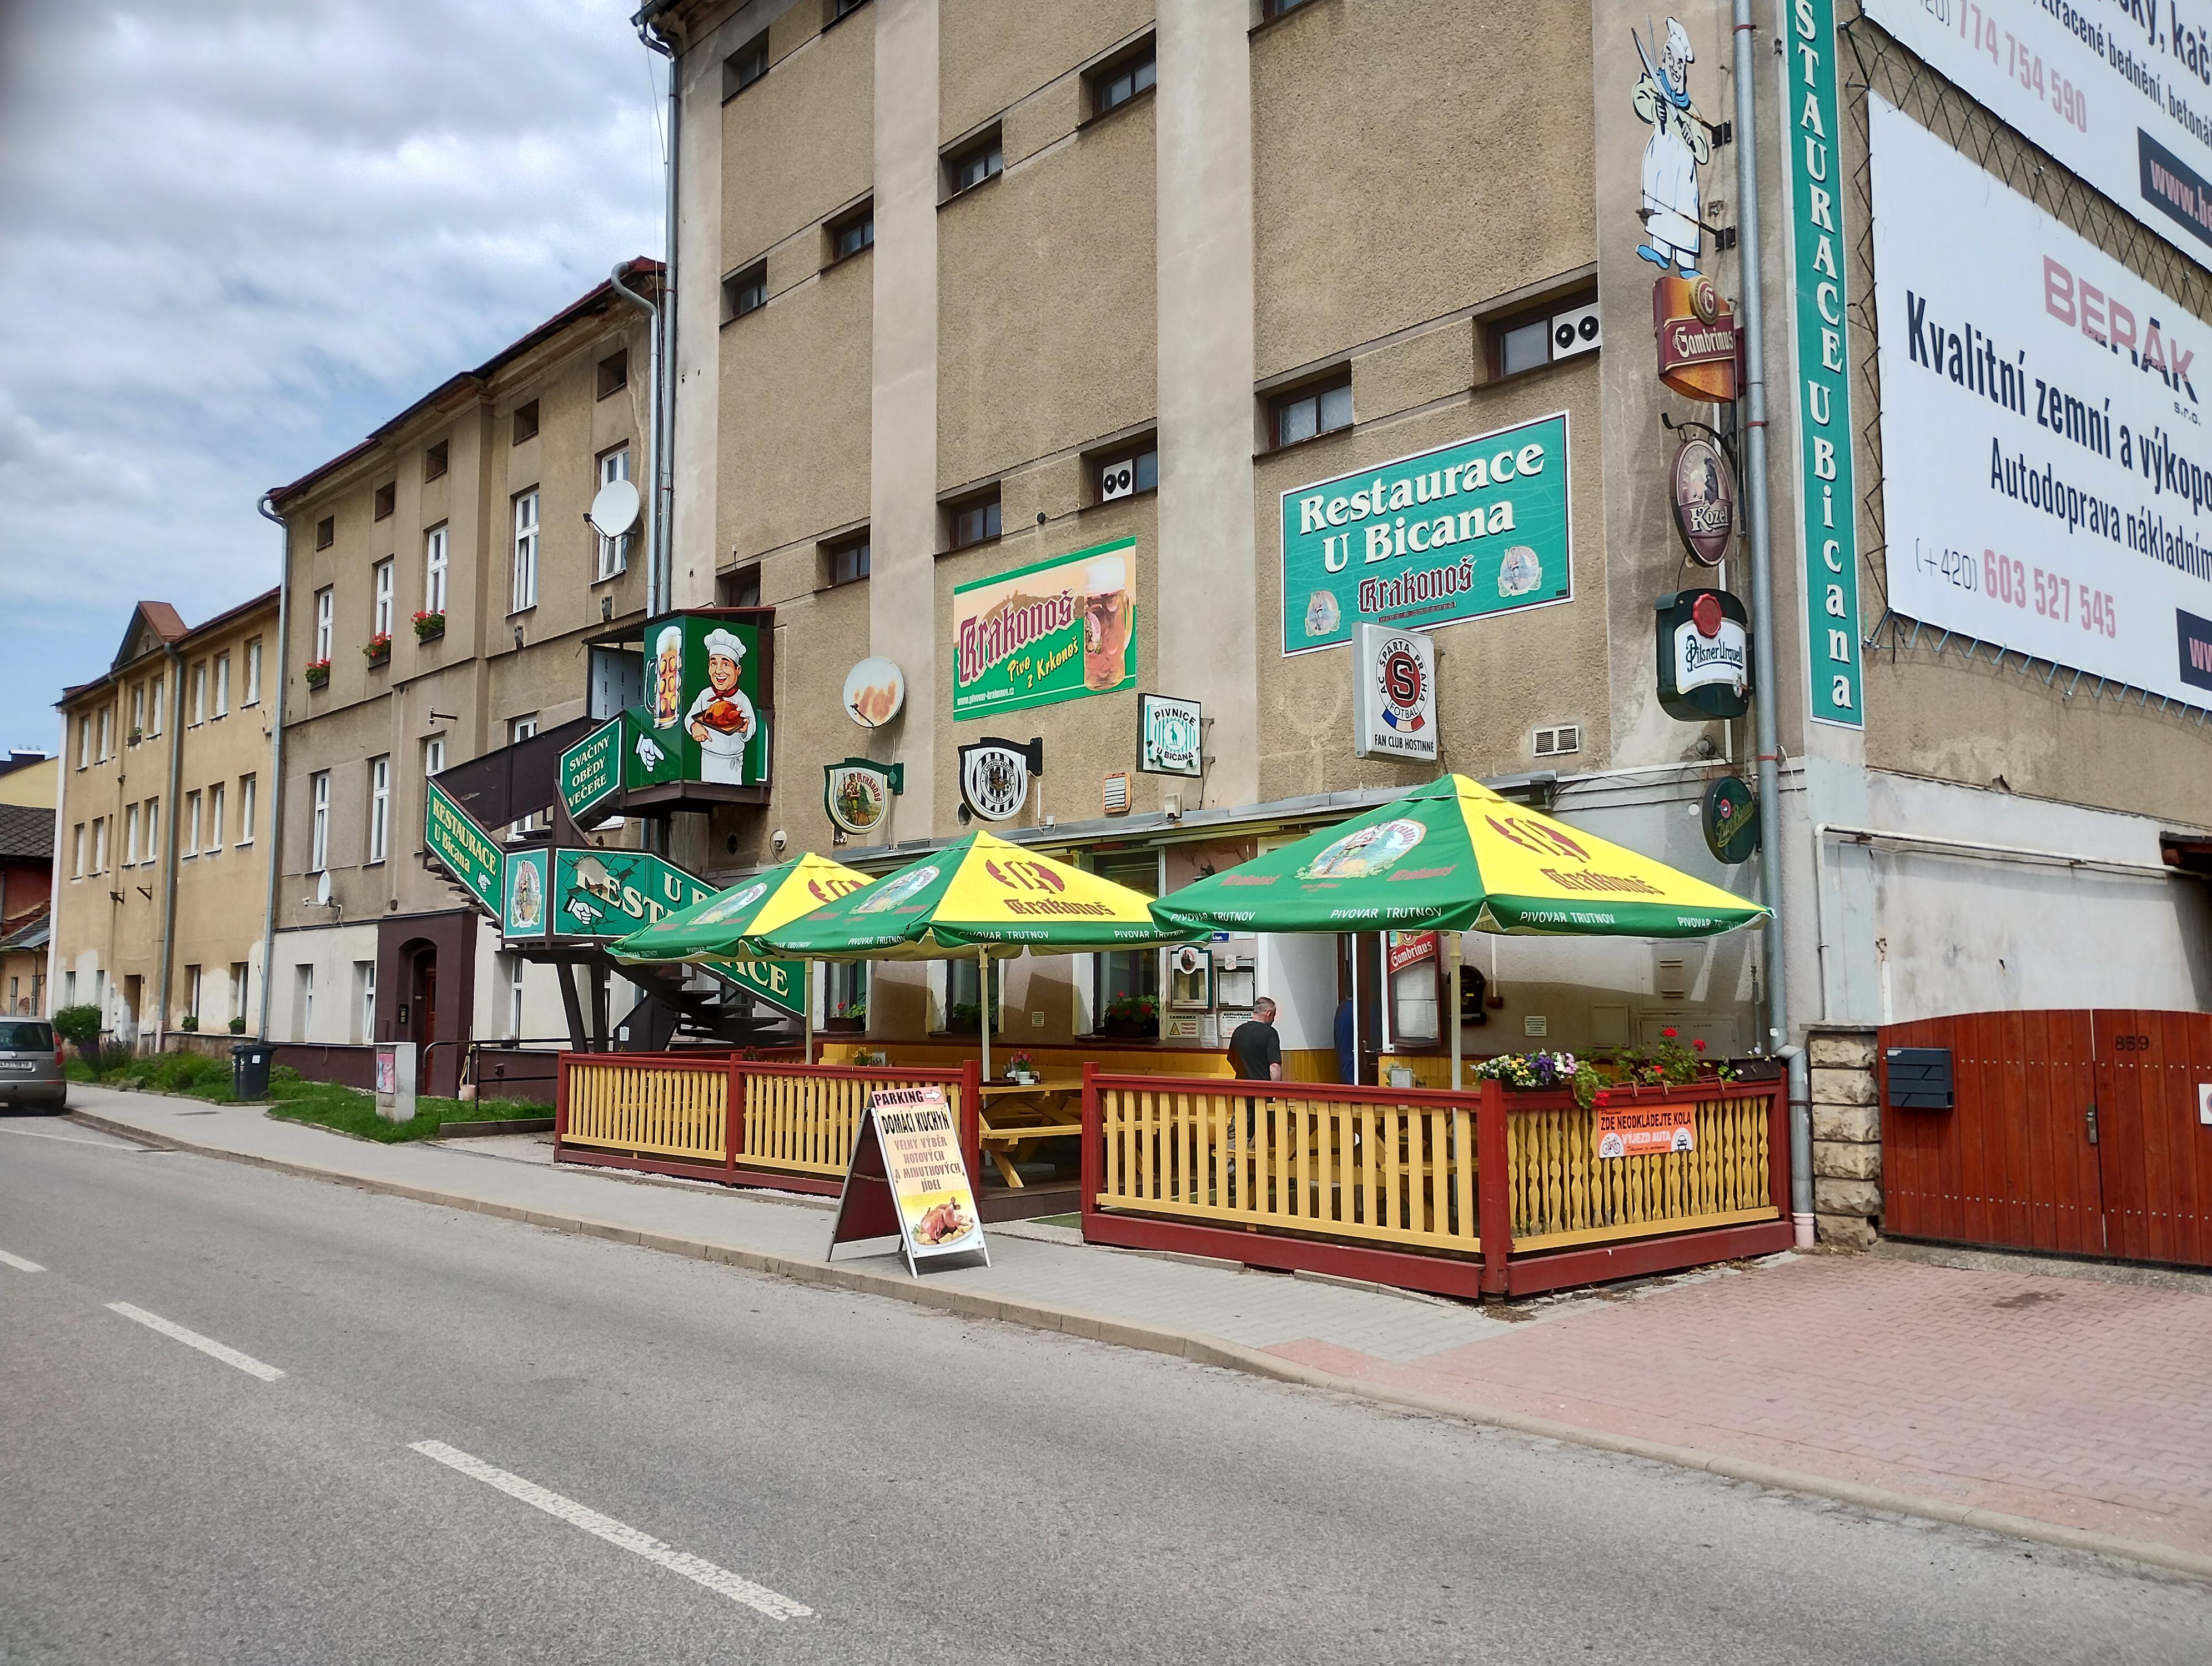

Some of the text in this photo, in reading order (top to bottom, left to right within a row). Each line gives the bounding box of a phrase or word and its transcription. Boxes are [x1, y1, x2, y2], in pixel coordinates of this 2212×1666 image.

[2170, 0, 2212, 86] kač
[1959, 0, 1999, 66] 774
[2005, 31, 2044, 101] 754
[2051, 68, 2087, 133] 590
[2108, 32, 2165, 114] bednění,
[1672, 327, 1733, 358] Gambrinus
[1808, 380, 1831, 426] U
[1907, 289, 2212, 516] Kvalitní zemní a výkopo
[2174, 402, 2201, 426] s.r.o.
[1299, 444, 1544, 536] Restaurace
[1991, 436, 2121, 543] Autodoprava
[1689, 505, 1729, 531] Kozel
[1323, 500, 1516, 573] U Bicana
[1359, 556, 1474, 613] Krakonoš
[1813, 436, 1852, 710] Bicana
[1916, 537, 2117, 639] (+420) 603 527 545
[959, 588, 1075, 688] Krakonoš
[1027, 636, 1079, 689] z Krkonoš
[1379, 641, 1410, 668] SPARTA
[1686, 634, 1743, 673] Pilsner Urquell
[1007, 655, 1031, 682] Pivo
[1414, 654, 1427, 702] PRAHA
[1378, 676, 1387, 694] AC
[1154, 708, 1197, 726] PIVNICE
[1389, 702, 1418, 719] FOTBAL
[569, 735, 610, 772] SVAČINY
[1157, 746, 1194, 761] U BICANA
[1374, 734, 1434, 752] FAN CLUB HOSTINNÉ
[571, 756, 606, 787] OBĚDY
[567, 774, 607, 809] VEČEŘE
[433, 796, 497, 876] RESTAURACE
[434, 822, 471, 874] U Bicana
[663, 872, 682, 901] U
[1540, 868, 1666, 895] Krakonoš
[1003, 899, 1116, 916] Krakonoš
[1212, 911, 1255, 921] TRUTNOV
[1330, 907, 1442, 919] PIVOVAR TRUTNOV
[1520, 911, 1616, 924] PIVOVAR TRUTNOV
[848, 937, 873, 945] PIVOVAR
[1006, 931, 1049, 940] TRUTNOV
[1114, 930, 1149, 939] PIVOVAR
[1391, 941, 1432, 967] Gambrinus
[2115, 1036, 2149, 1051] 859
[874, 1090, 924, 1106] PARKING
[881, 1110, 916, 1135] DOMÁCÍ
[1601, 1111, 1691, 1131] ZDE NEODKLÁDEJTE KOLA
[894, 1134, 947, 1151] VELKÝ VÝBĚR
[1622, 1131, 1671, 1145] VÝJEZD AUTA
[903, 1149, 944, 1165] HOTOVÝCH
[895, 1162, 961, 1180] A MINUTKOVÝCH
[922, 1177, 942, 1192] JÍDEL
